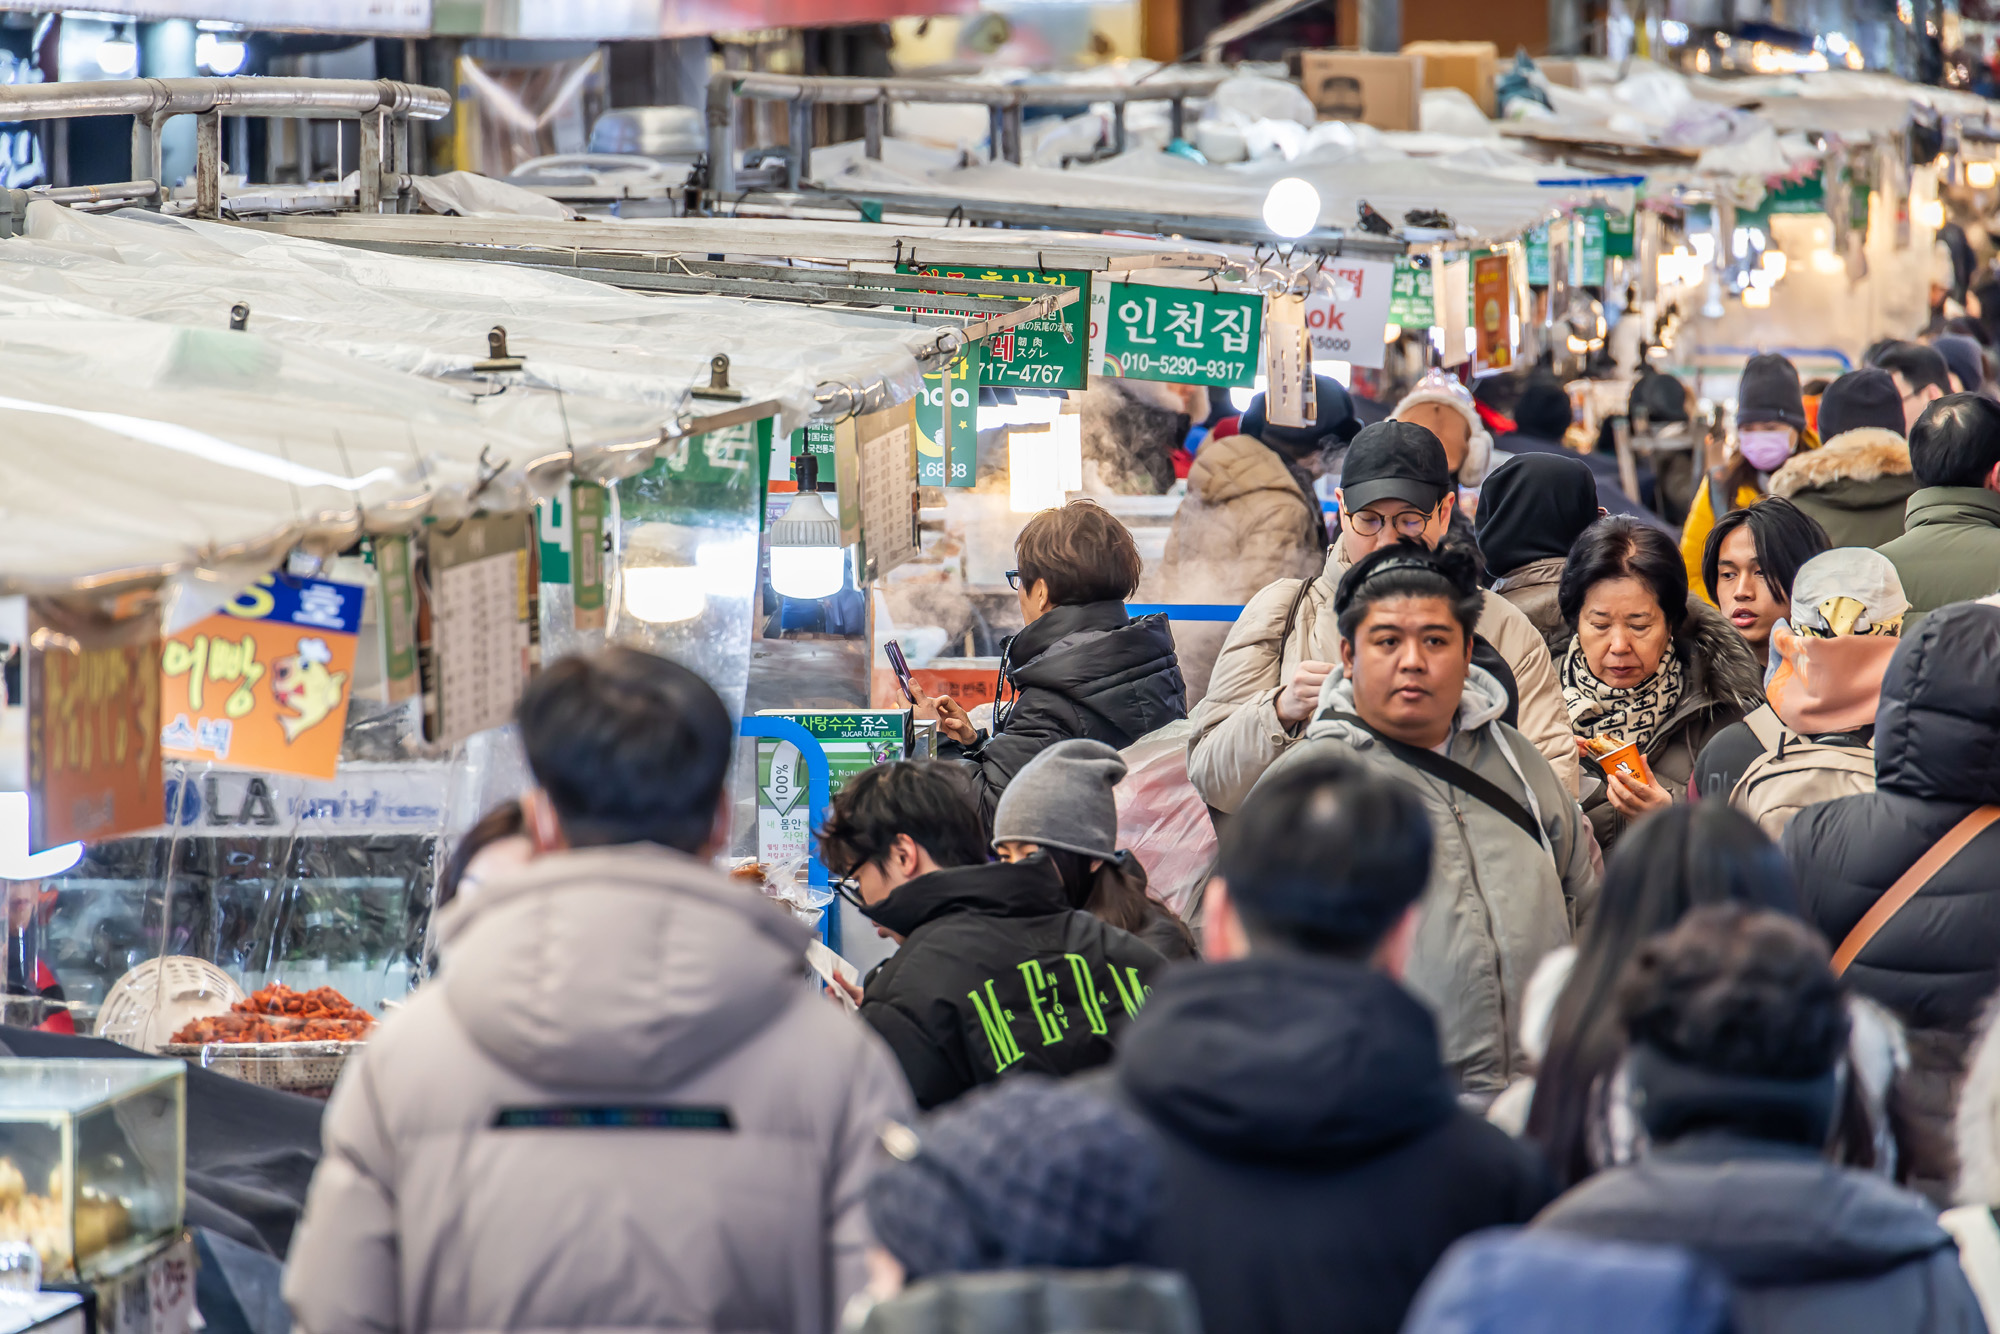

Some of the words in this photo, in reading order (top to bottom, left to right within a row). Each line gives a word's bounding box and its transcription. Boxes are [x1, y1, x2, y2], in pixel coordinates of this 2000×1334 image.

[1118, 297, 1252, 354] 인천집
[1308, 304, 1345, 331] ok
[1120, 351, 1246, 380] 010-5290-9317
[917, 462, 967, 478] .6888
[801, 716, 857, 732] 사탕수수
[860, 716, 889, 731] 쥬스
[880, 730, 897, 738] JUICE
[775, 764, 789, 801] 100%
